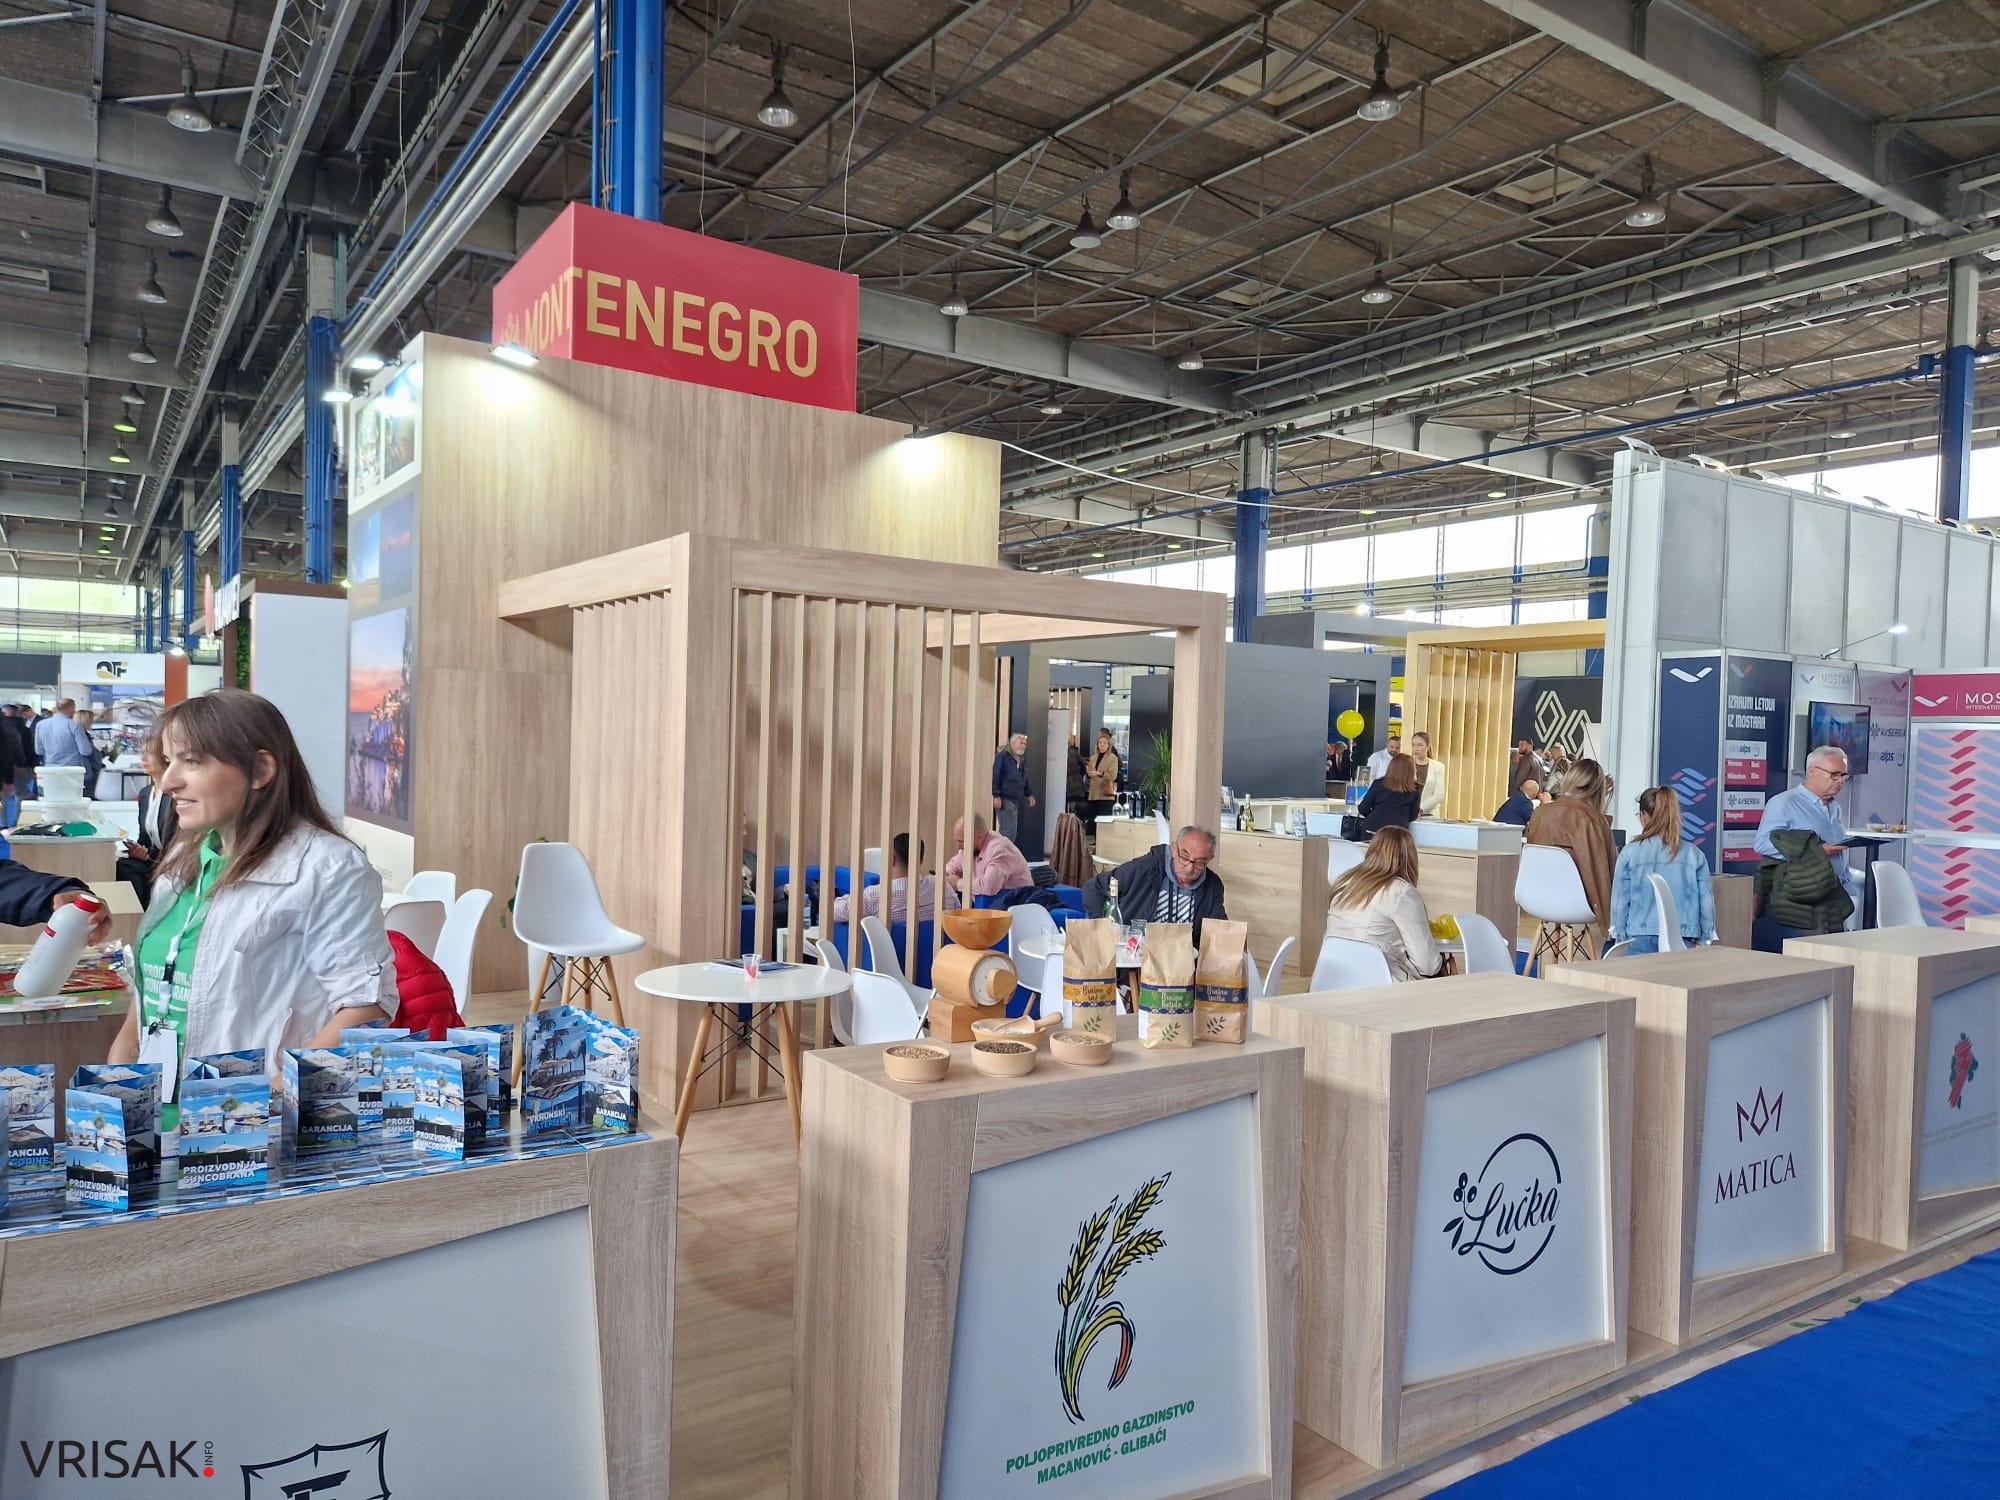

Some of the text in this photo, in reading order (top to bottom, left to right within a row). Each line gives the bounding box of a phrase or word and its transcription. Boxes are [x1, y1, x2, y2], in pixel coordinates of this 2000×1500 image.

[525, 266, 818, 378] MONTENEGRO
[1727, 714, 1766, 730] IZ MOSTARA
[301, 1124, 353, 1134] GARANCIJA
[183, 1160, 258, 1175] PROIZVODNJA
[183, 1169, 256, 1184] SUNCOBRANA
[1714, 1151, 1798, 1205] MATICA
[69, 1178, 121, 1194] PROIZVODNJA
[67, 1189, 120, 1204] SUNCOBRANA
[1005, 1399, 1195, 1474] POLJOPRIVREDNO GAZDINSTVO
[1036, 1443, 1112, 1485] MACANOVIĆ
[1120, 1426, 1167, 1456] GLIBAĆI
